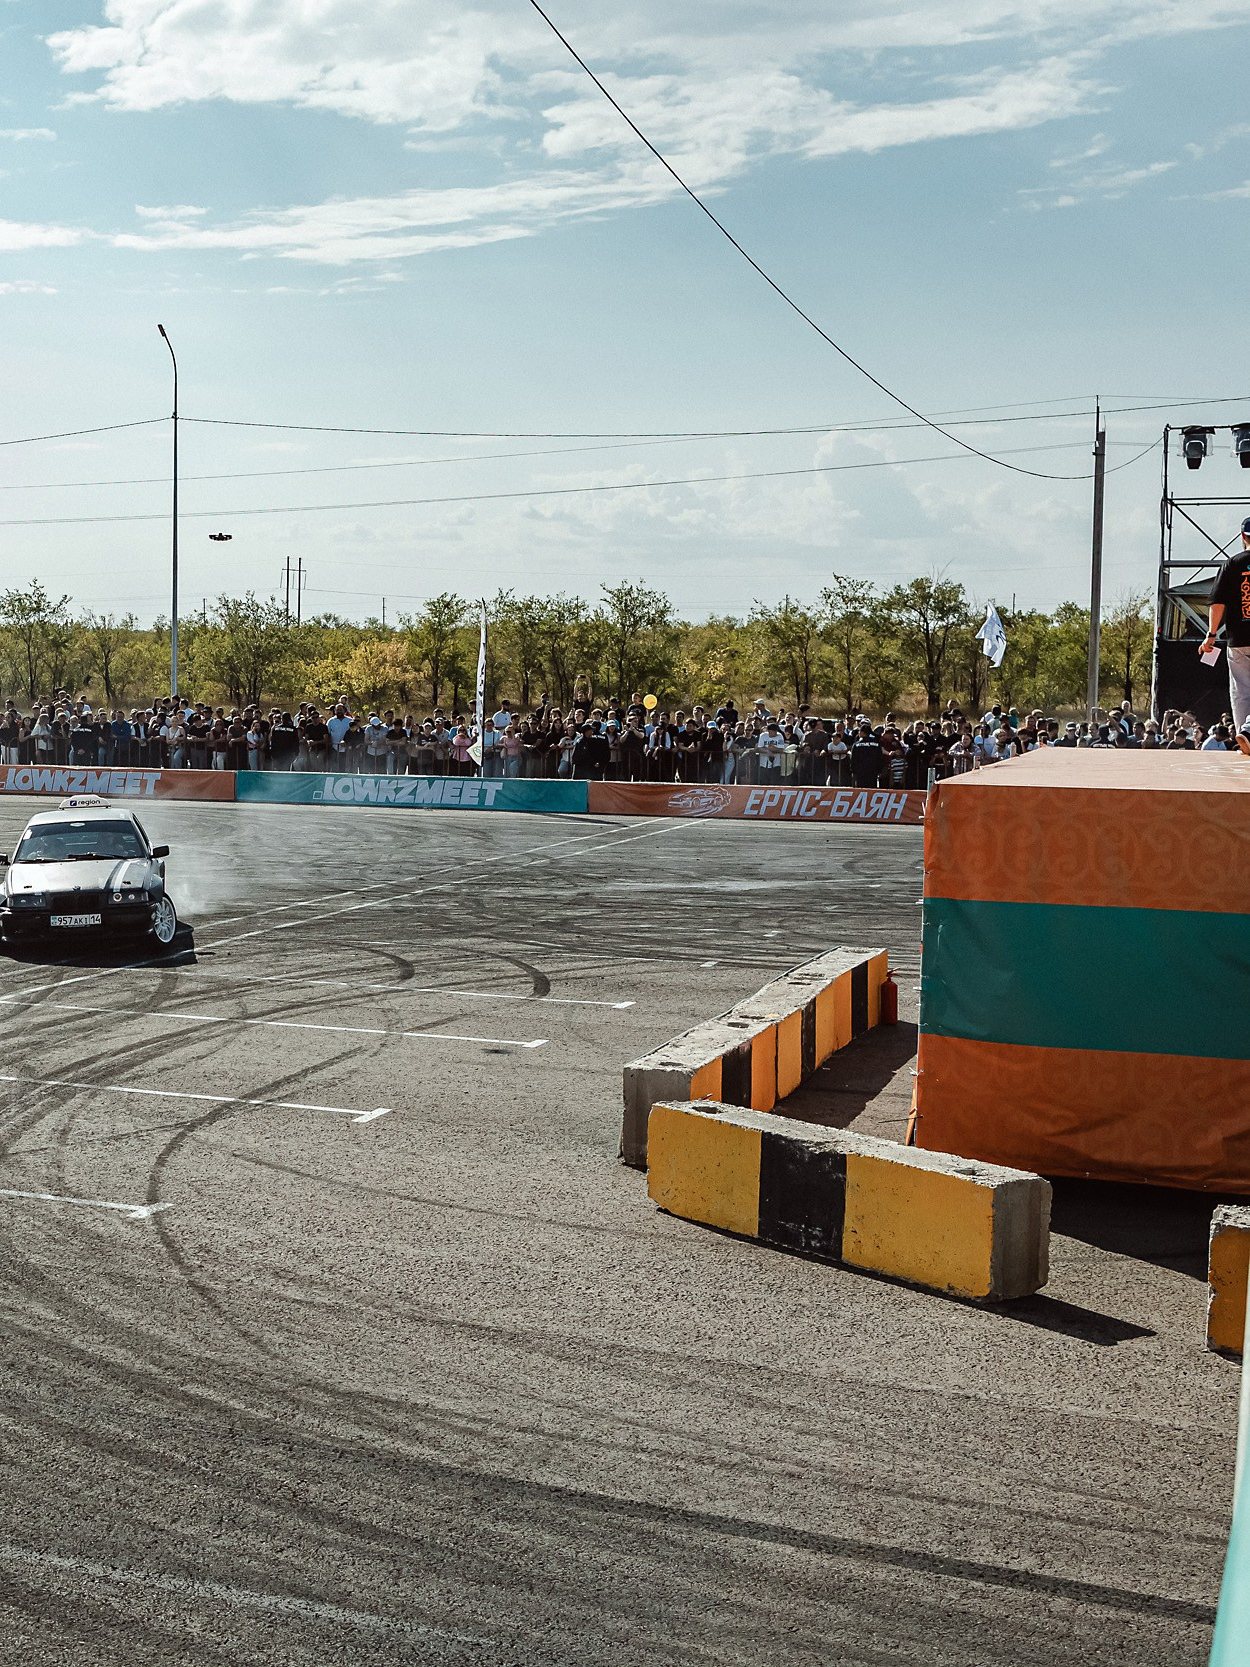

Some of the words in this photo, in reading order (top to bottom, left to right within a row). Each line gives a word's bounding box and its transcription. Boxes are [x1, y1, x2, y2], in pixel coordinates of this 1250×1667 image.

[5, 768, 162, 795] LOWKZMEET
[322, 777, 503, 806] LOWKZMEET
[743, 789, 908, 820] ЕРТІС-БАЯН
